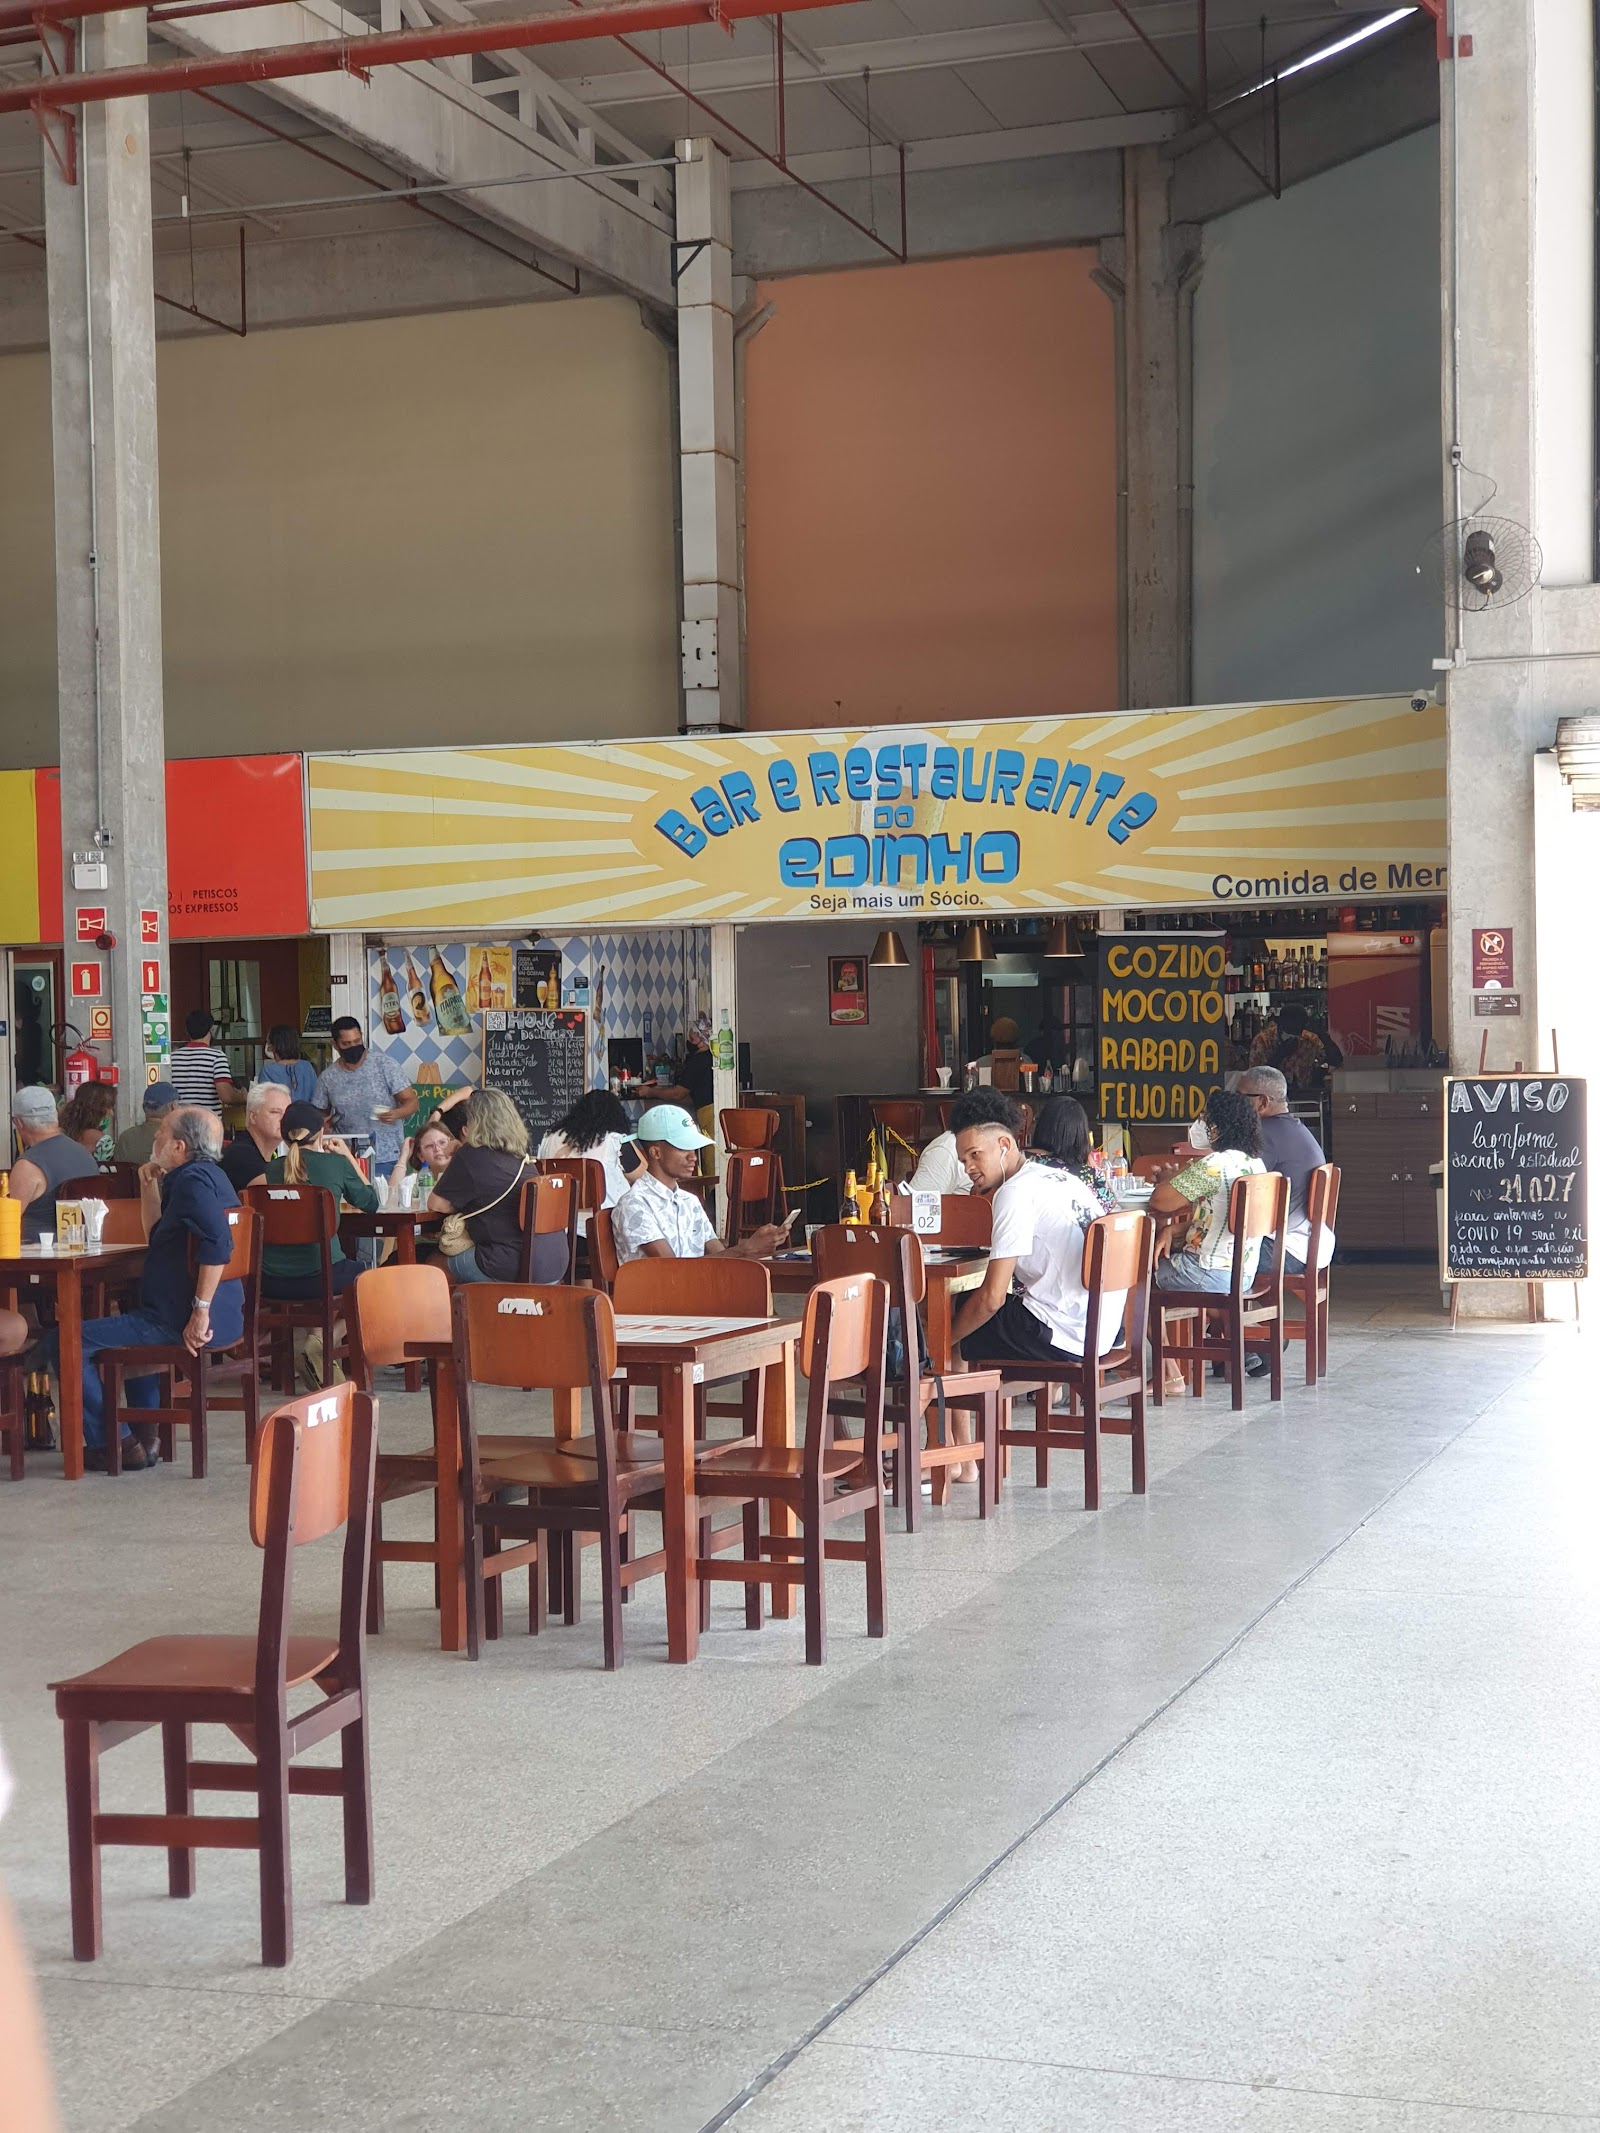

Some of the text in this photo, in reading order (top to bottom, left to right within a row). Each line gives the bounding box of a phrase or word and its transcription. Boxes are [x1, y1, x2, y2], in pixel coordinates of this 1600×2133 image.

[873, 805, 915, 829] DO
[192, 888, 238, 899] PETISCOS
[1212, 863, 1448, 899] Comida de Mer
[185, 902, 239, 914] EXPRESSOS
[810, 890, 984, 912] Seja mais um Sócio.
[1107, 944, 1226, 979] COZIDO
[1102, 980, 1223, 1024] MOCOTÓ
[1101, 1036, 1219, 1074] RABADA
[1101, 1082, 1223, 1120] FEIJOAD
[1450, 1081, 1570, 1113] AVISO
[1498, 1171, 1576, 1203] 21.027
[61, 1212, 77, 1230] 51
[918, 1216, 935, 1229] 02
[1457, 1225, 1499, 1241] COVID
[1507, 1224, 1523, 1241] 19
